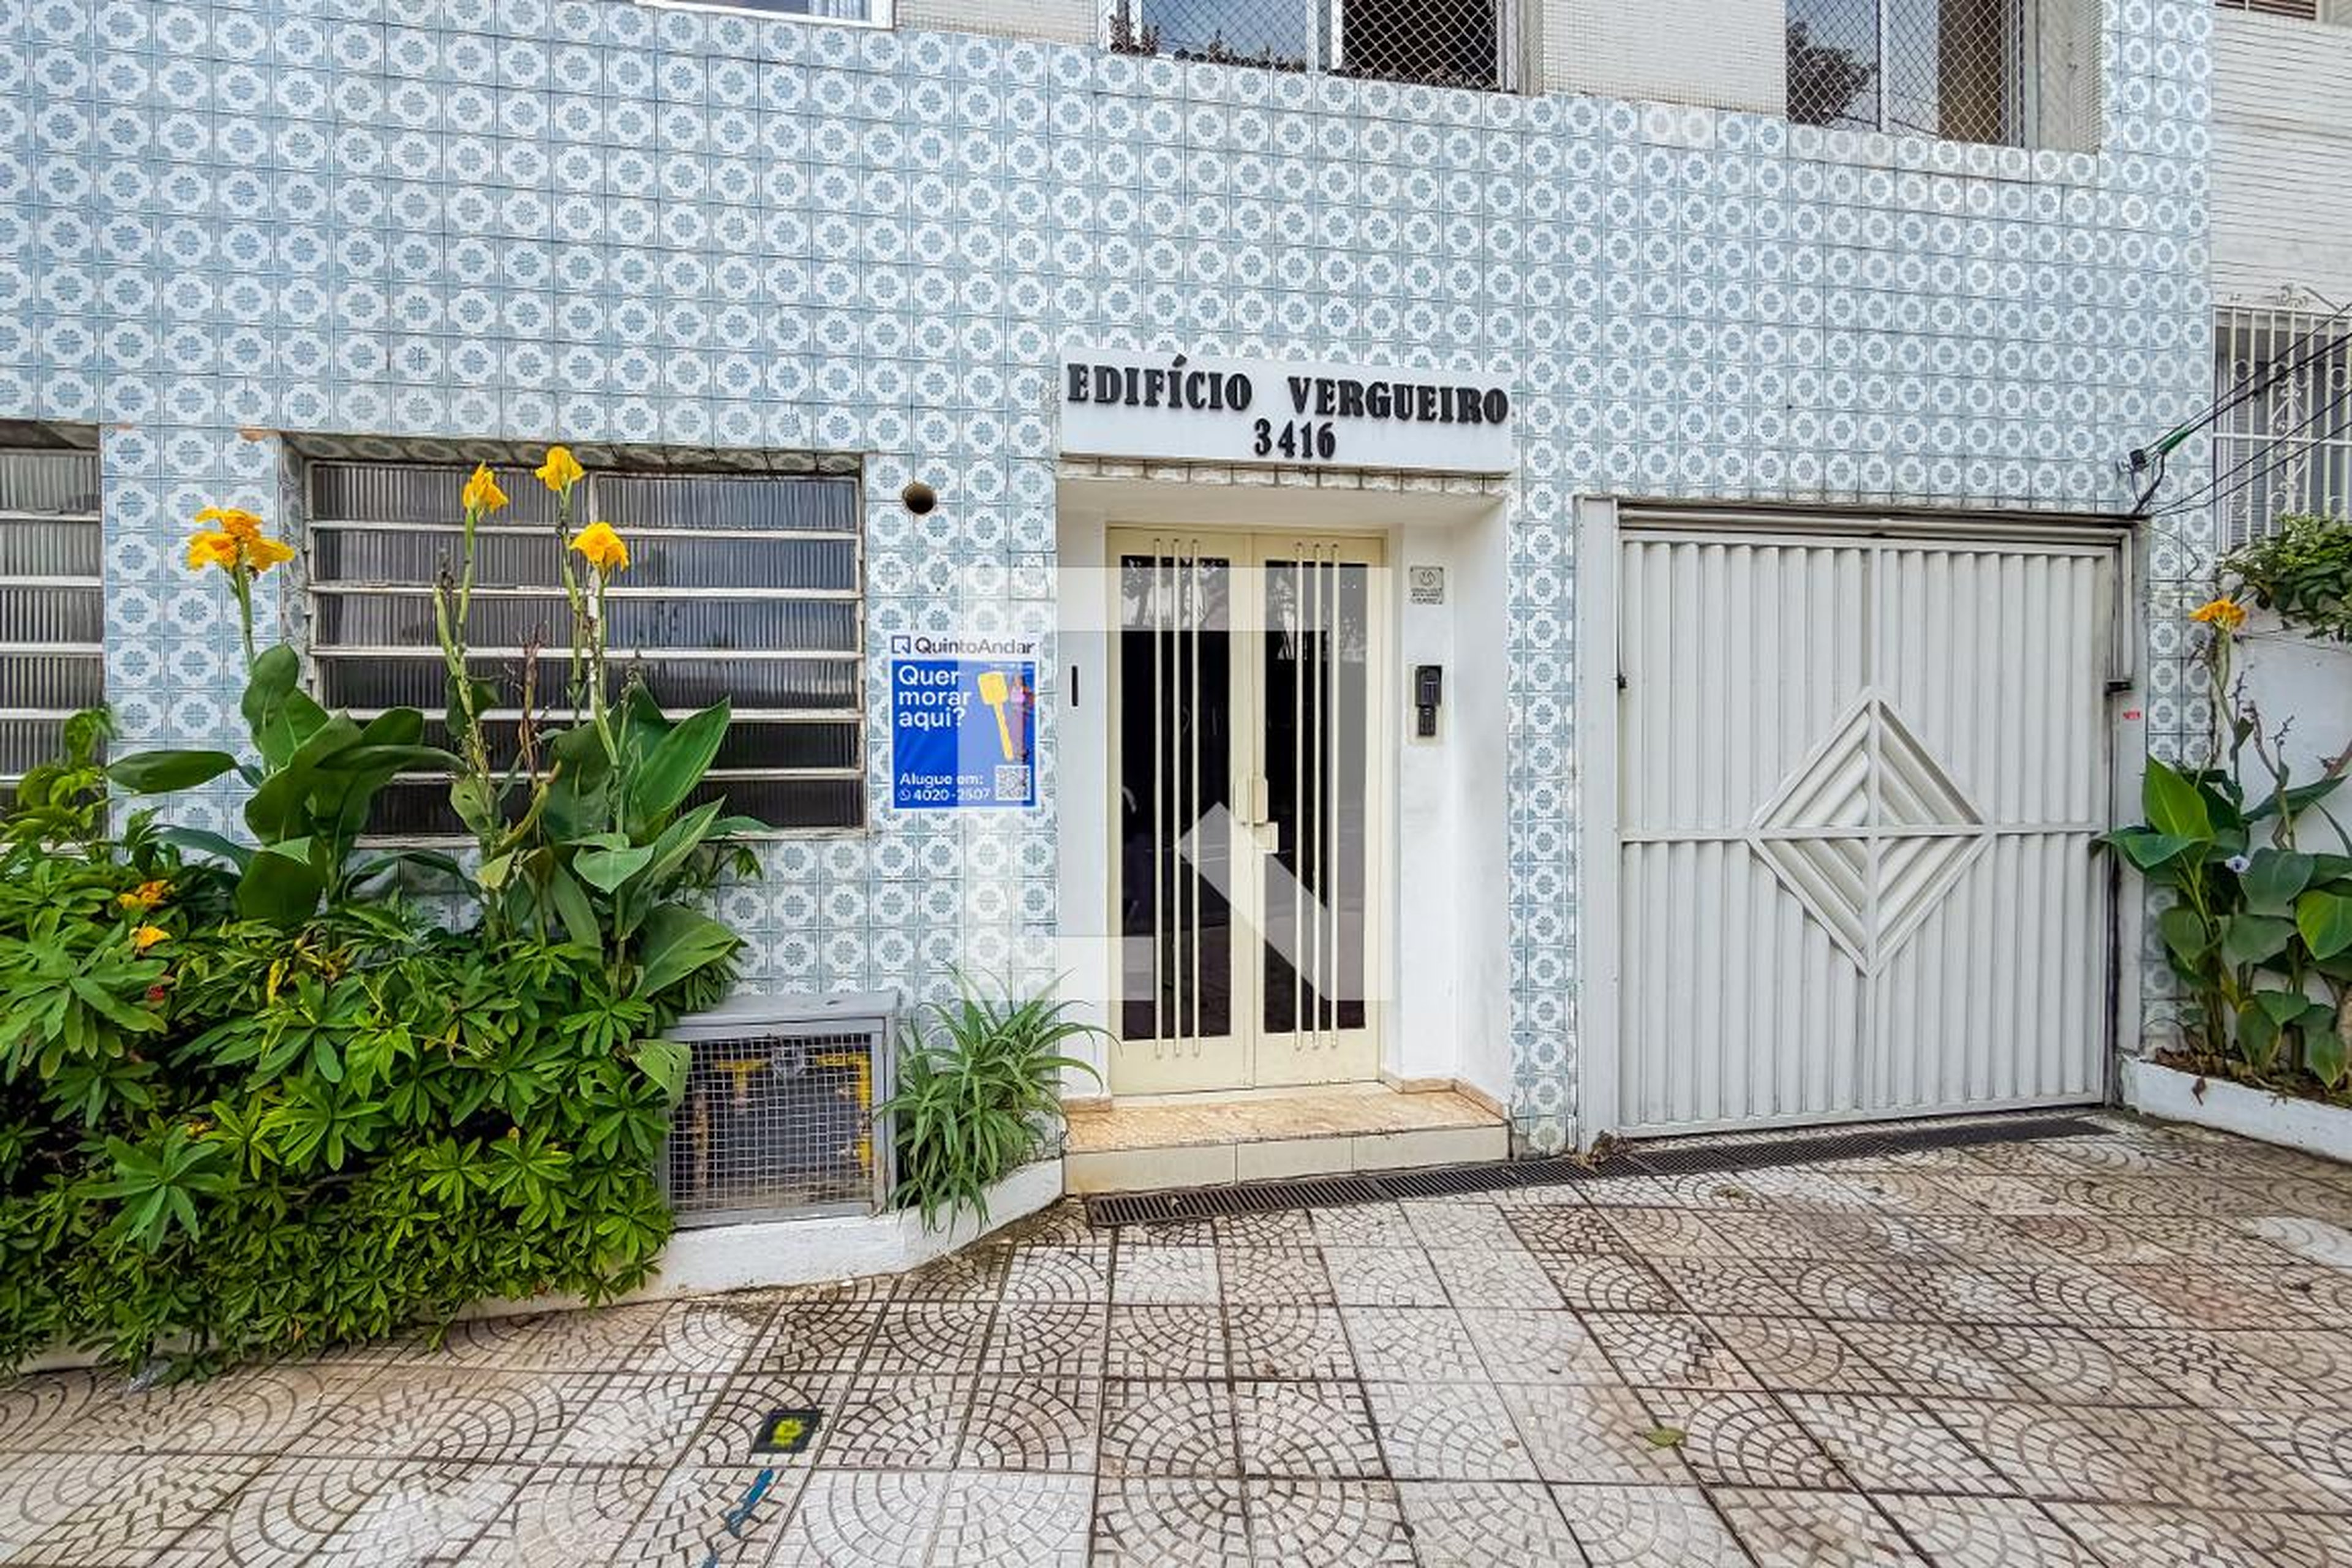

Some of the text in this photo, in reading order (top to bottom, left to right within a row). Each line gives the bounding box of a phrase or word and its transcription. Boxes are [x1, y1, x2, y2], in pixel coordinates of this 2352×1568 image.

[1068, 354, 1509, 424] EDIFÍCIO VERGUEIRO
[1254, 418, 1336, 459] 3416
[915, 638, 1035, 655] QuintoAndar
[899, 666, 959, 685] Quer
[899, 691, 972, 706] morar
[899, 707, 965, 731] aqui?
[899, 772, 952, 788] Alugue
